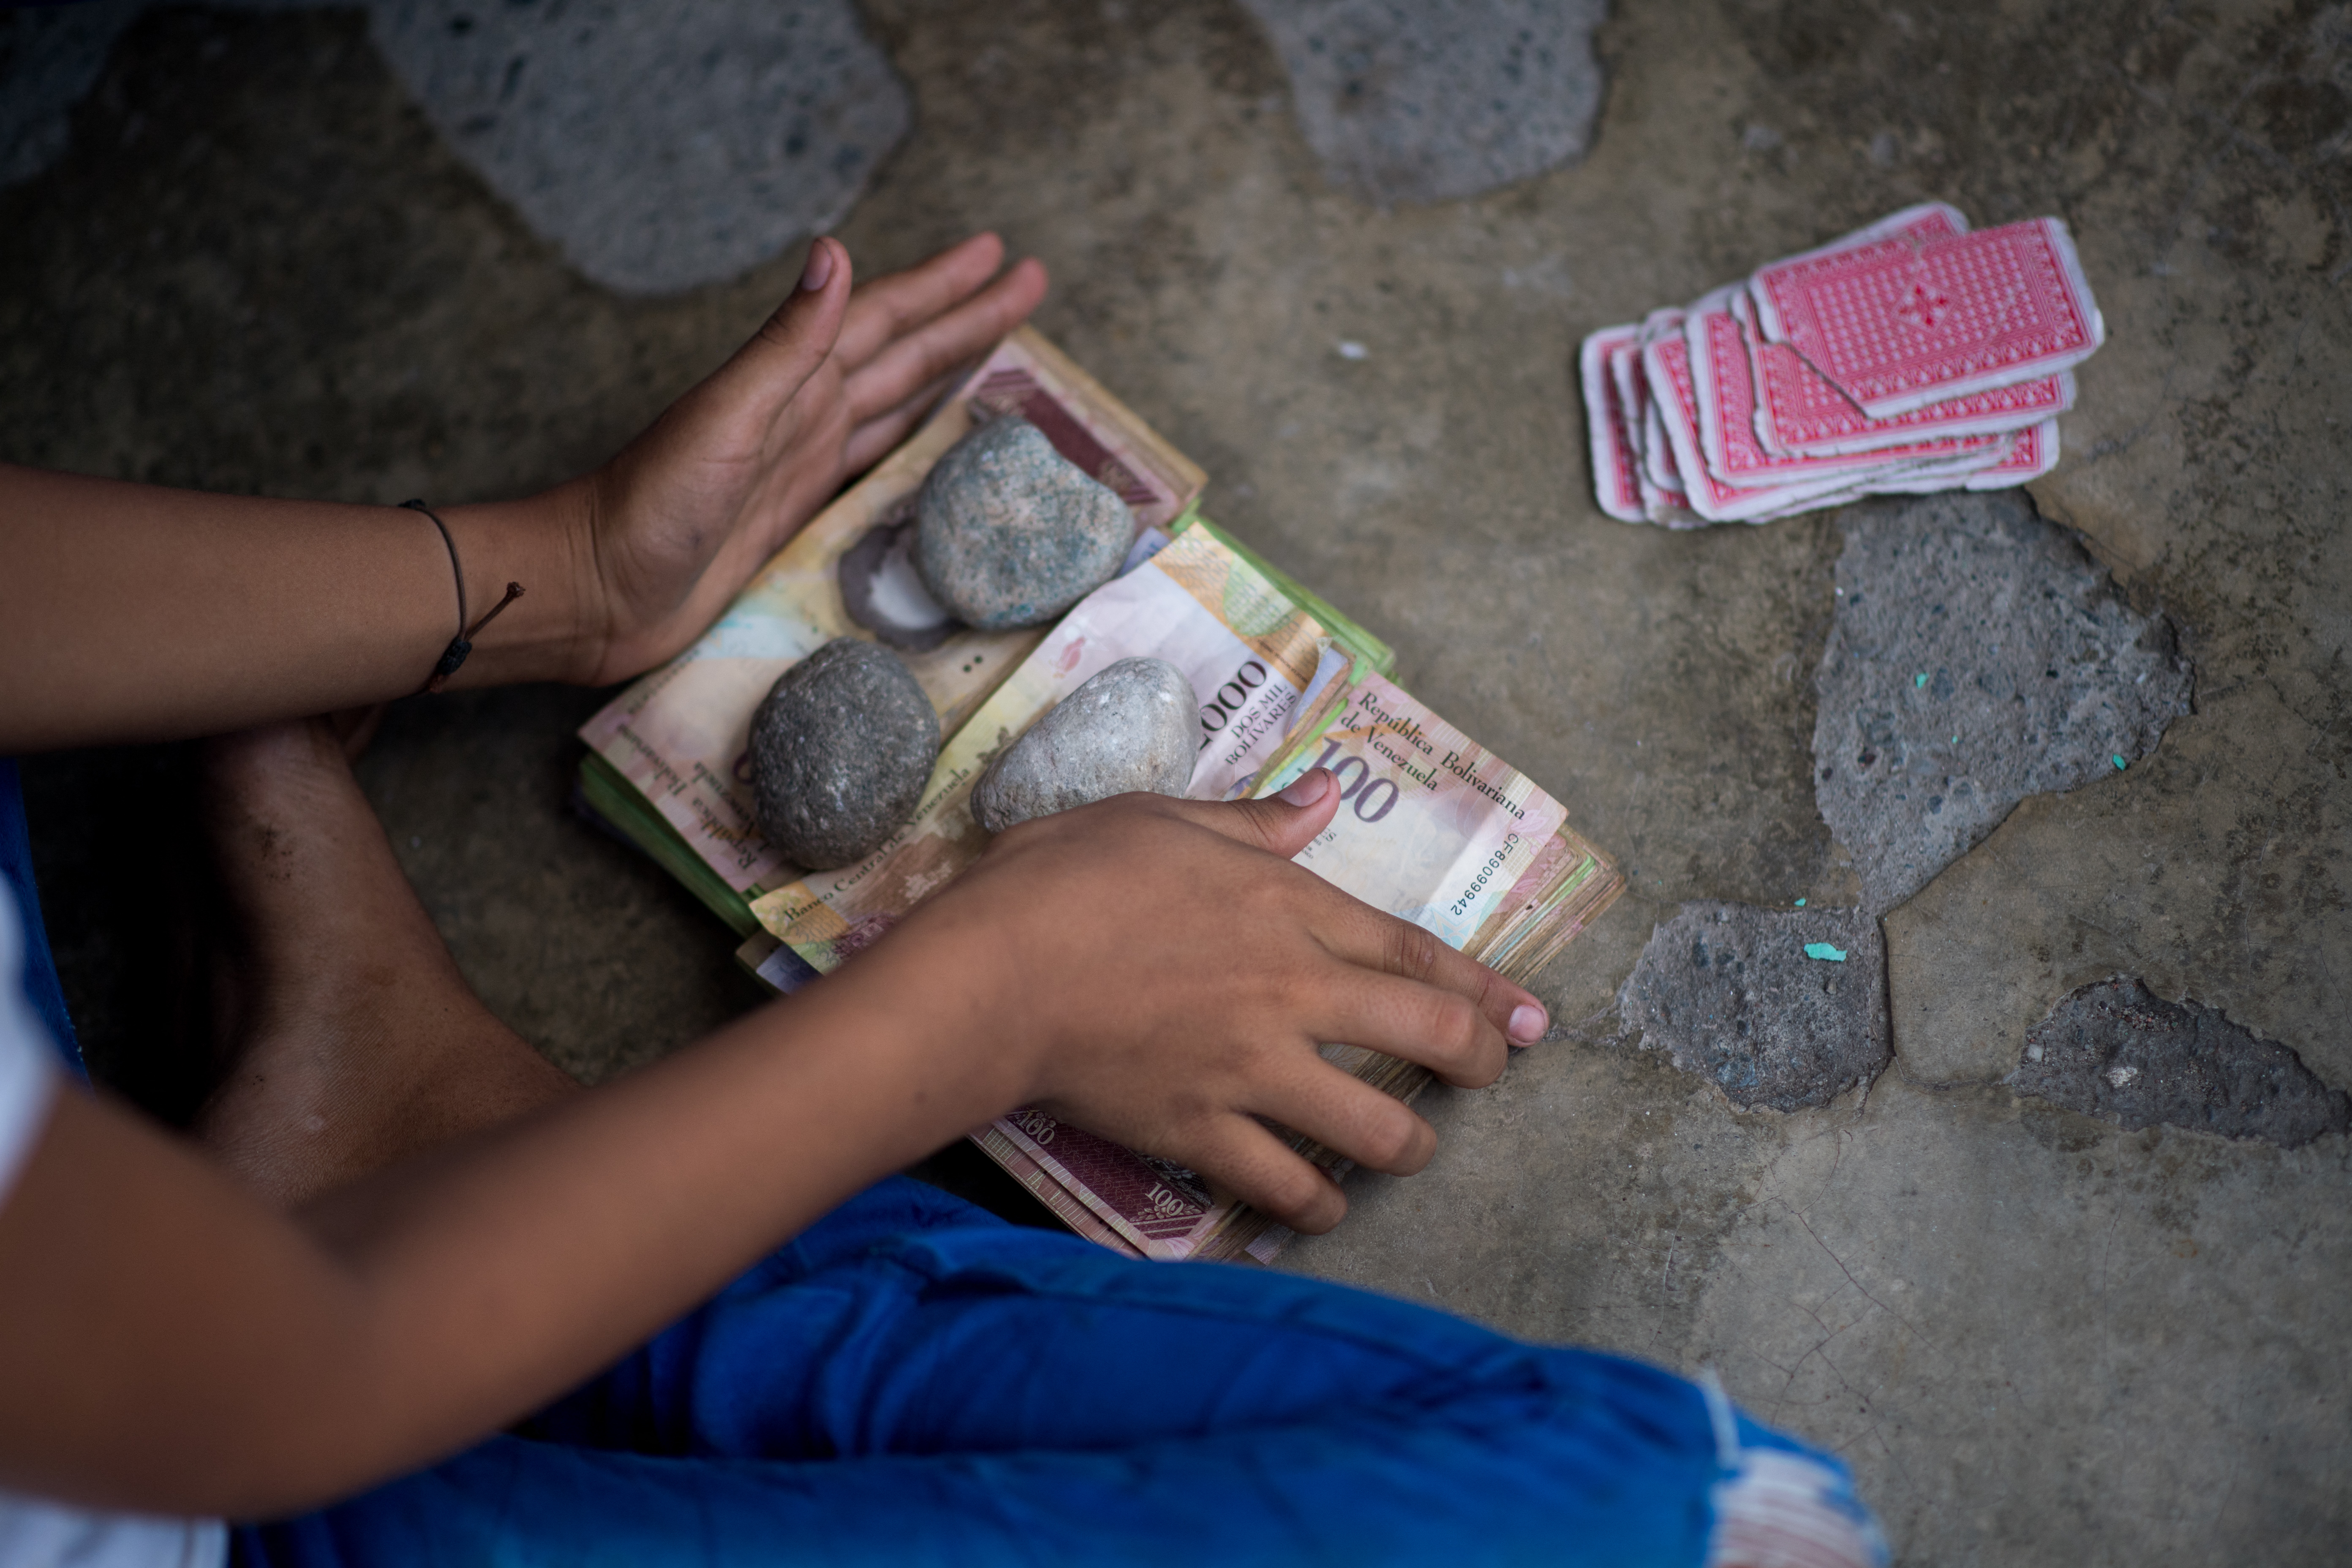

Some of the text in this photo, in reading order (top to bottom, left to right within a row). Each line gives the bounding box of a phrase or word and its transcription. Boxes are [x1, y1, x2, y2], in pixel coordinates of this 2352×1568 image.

[1200, 661, 1267, 750] 000
[1225, 692, 1297, 765] BOLÍVARES
[1230, 683, 1288, 739] DOS MIL
[1297, 737, 1399, 823] 100
[1341, 712, 1437, 791] de Venezuela
[1358, 691, 1525, 820] República Bolivariana
[783, 768, 970, 920] Banco Central de Venezuela
[1450, 833, 1519, 916] CF89099942
[1016, 1110, 1055, 1144] 100
[1145, 1182, 1184, 1216] 100
